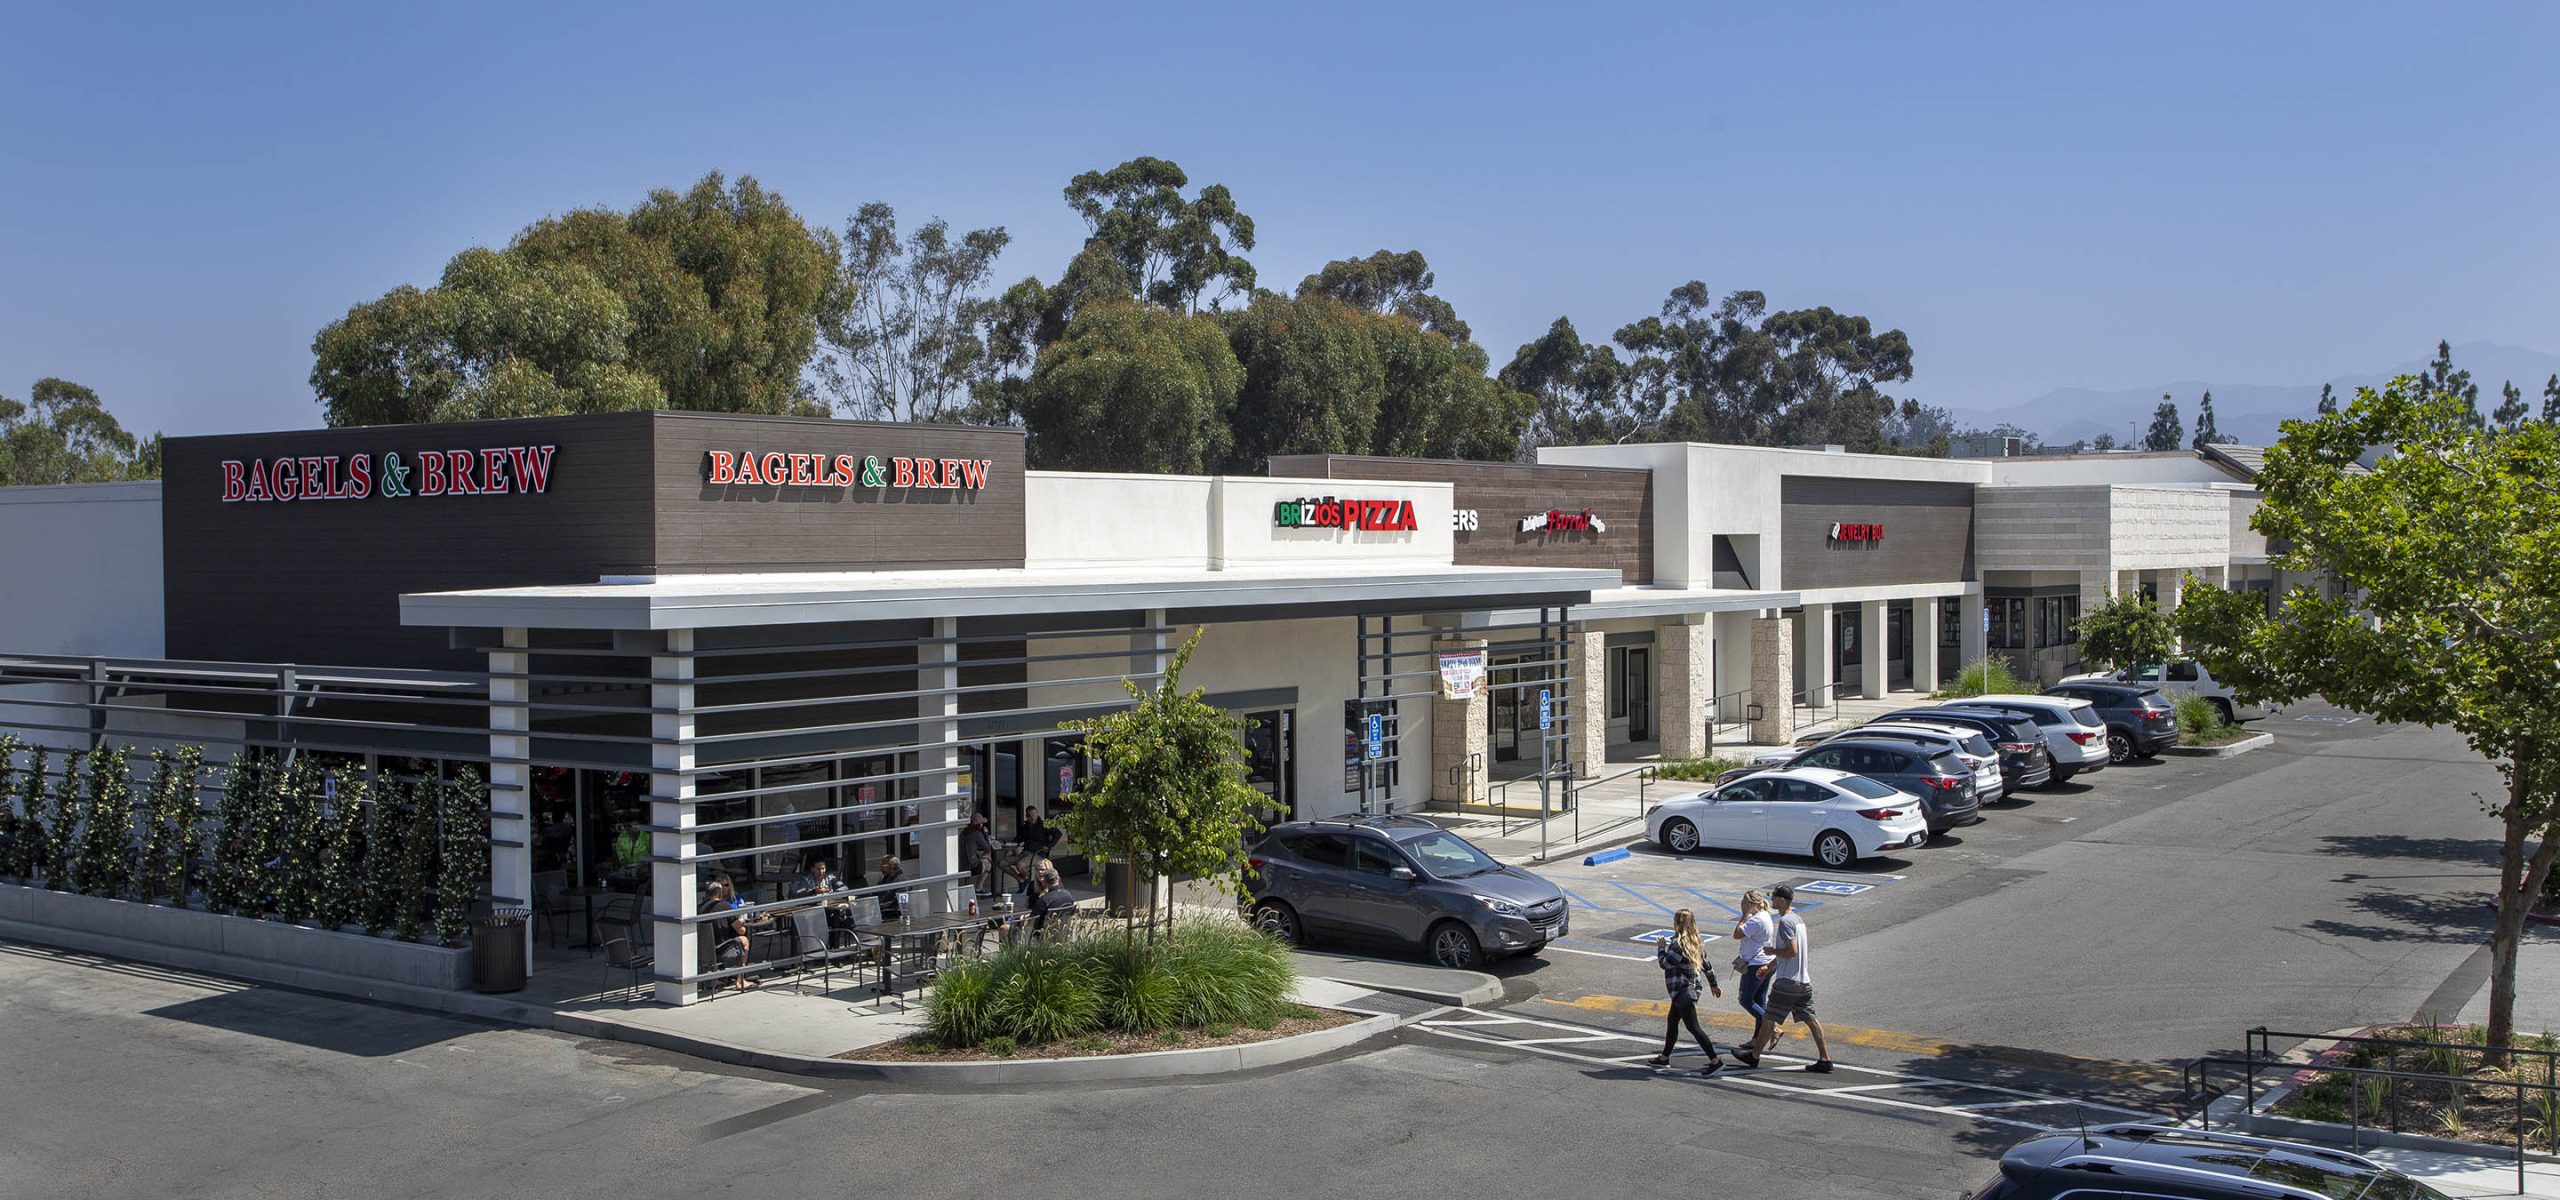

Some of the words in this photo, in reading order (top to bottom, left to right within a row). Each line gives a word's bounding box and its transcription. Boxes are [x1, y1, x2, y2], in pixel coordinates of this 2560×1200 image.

[221, 453, 372, 502] BAGELS
[381, 451, 411, 498] &
[418, 445, 556, 497] BREW
[709, 450, 855, 487] BAGELS
[862, 455, 887, 488] &
[893, 456, 991, 490] BREW
[1343, 500, 1418, 531] PIZZA
